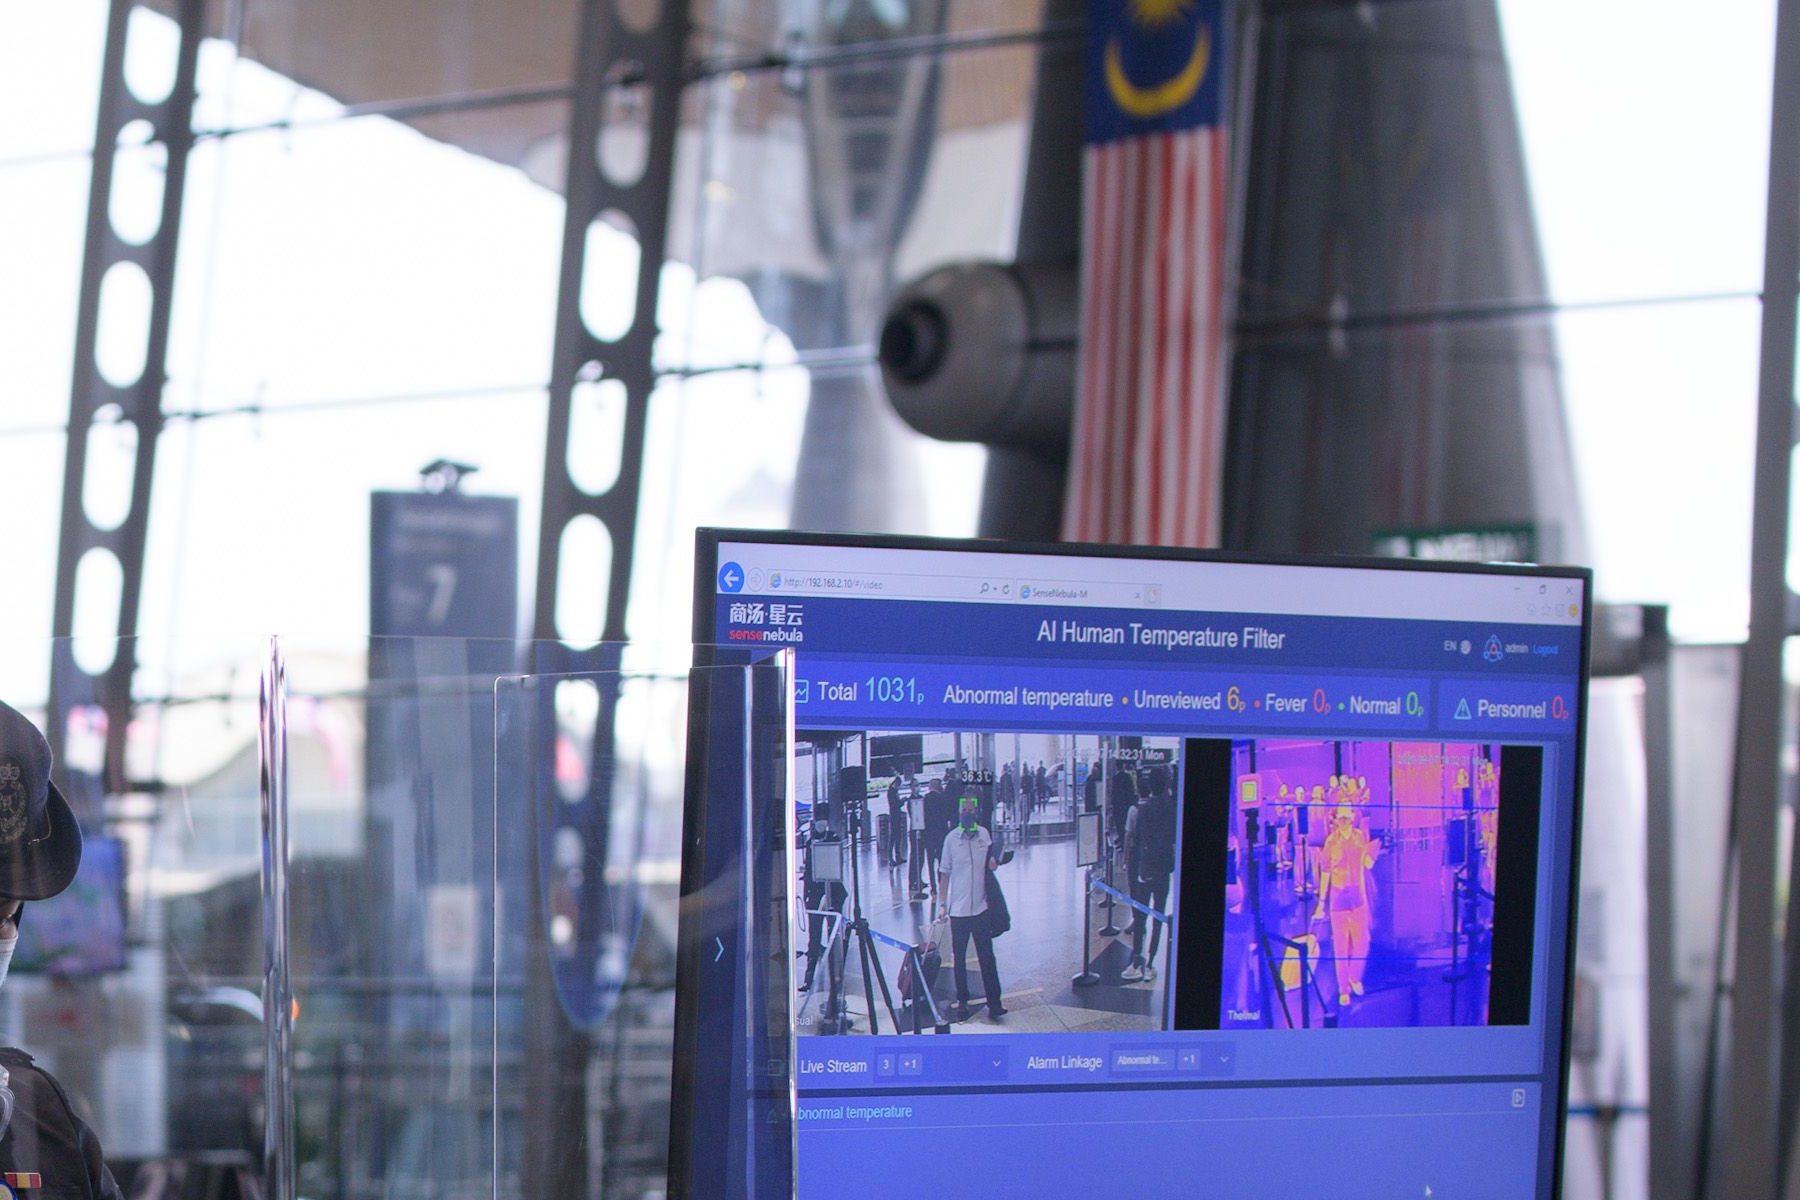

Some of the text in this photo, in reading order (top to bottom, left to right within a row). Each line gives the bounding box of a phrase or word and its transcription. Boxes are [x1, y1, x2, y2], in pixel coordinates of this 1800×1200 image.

[1037, 619, 1286, 651] AI Human Temperature Filter
[817, 681, 858, 701] Total
[943, 684, 1114, 711] Abnormal temperature
[1134, 689, 1221, 710] Unreviewed
[1265, 692, 1307, 713] Fever
[1350, 694, 1401, 715] Normal
[1477, 699, 1546, 720] Personnel
[795, 1015, 814, 1027] sual
[800, 1059, 867, 1073] Live Stream
[1027, 1055, 1103, 1072] Alarm Linkage
[797, 1105, 913, 1121] bnormal temperature
